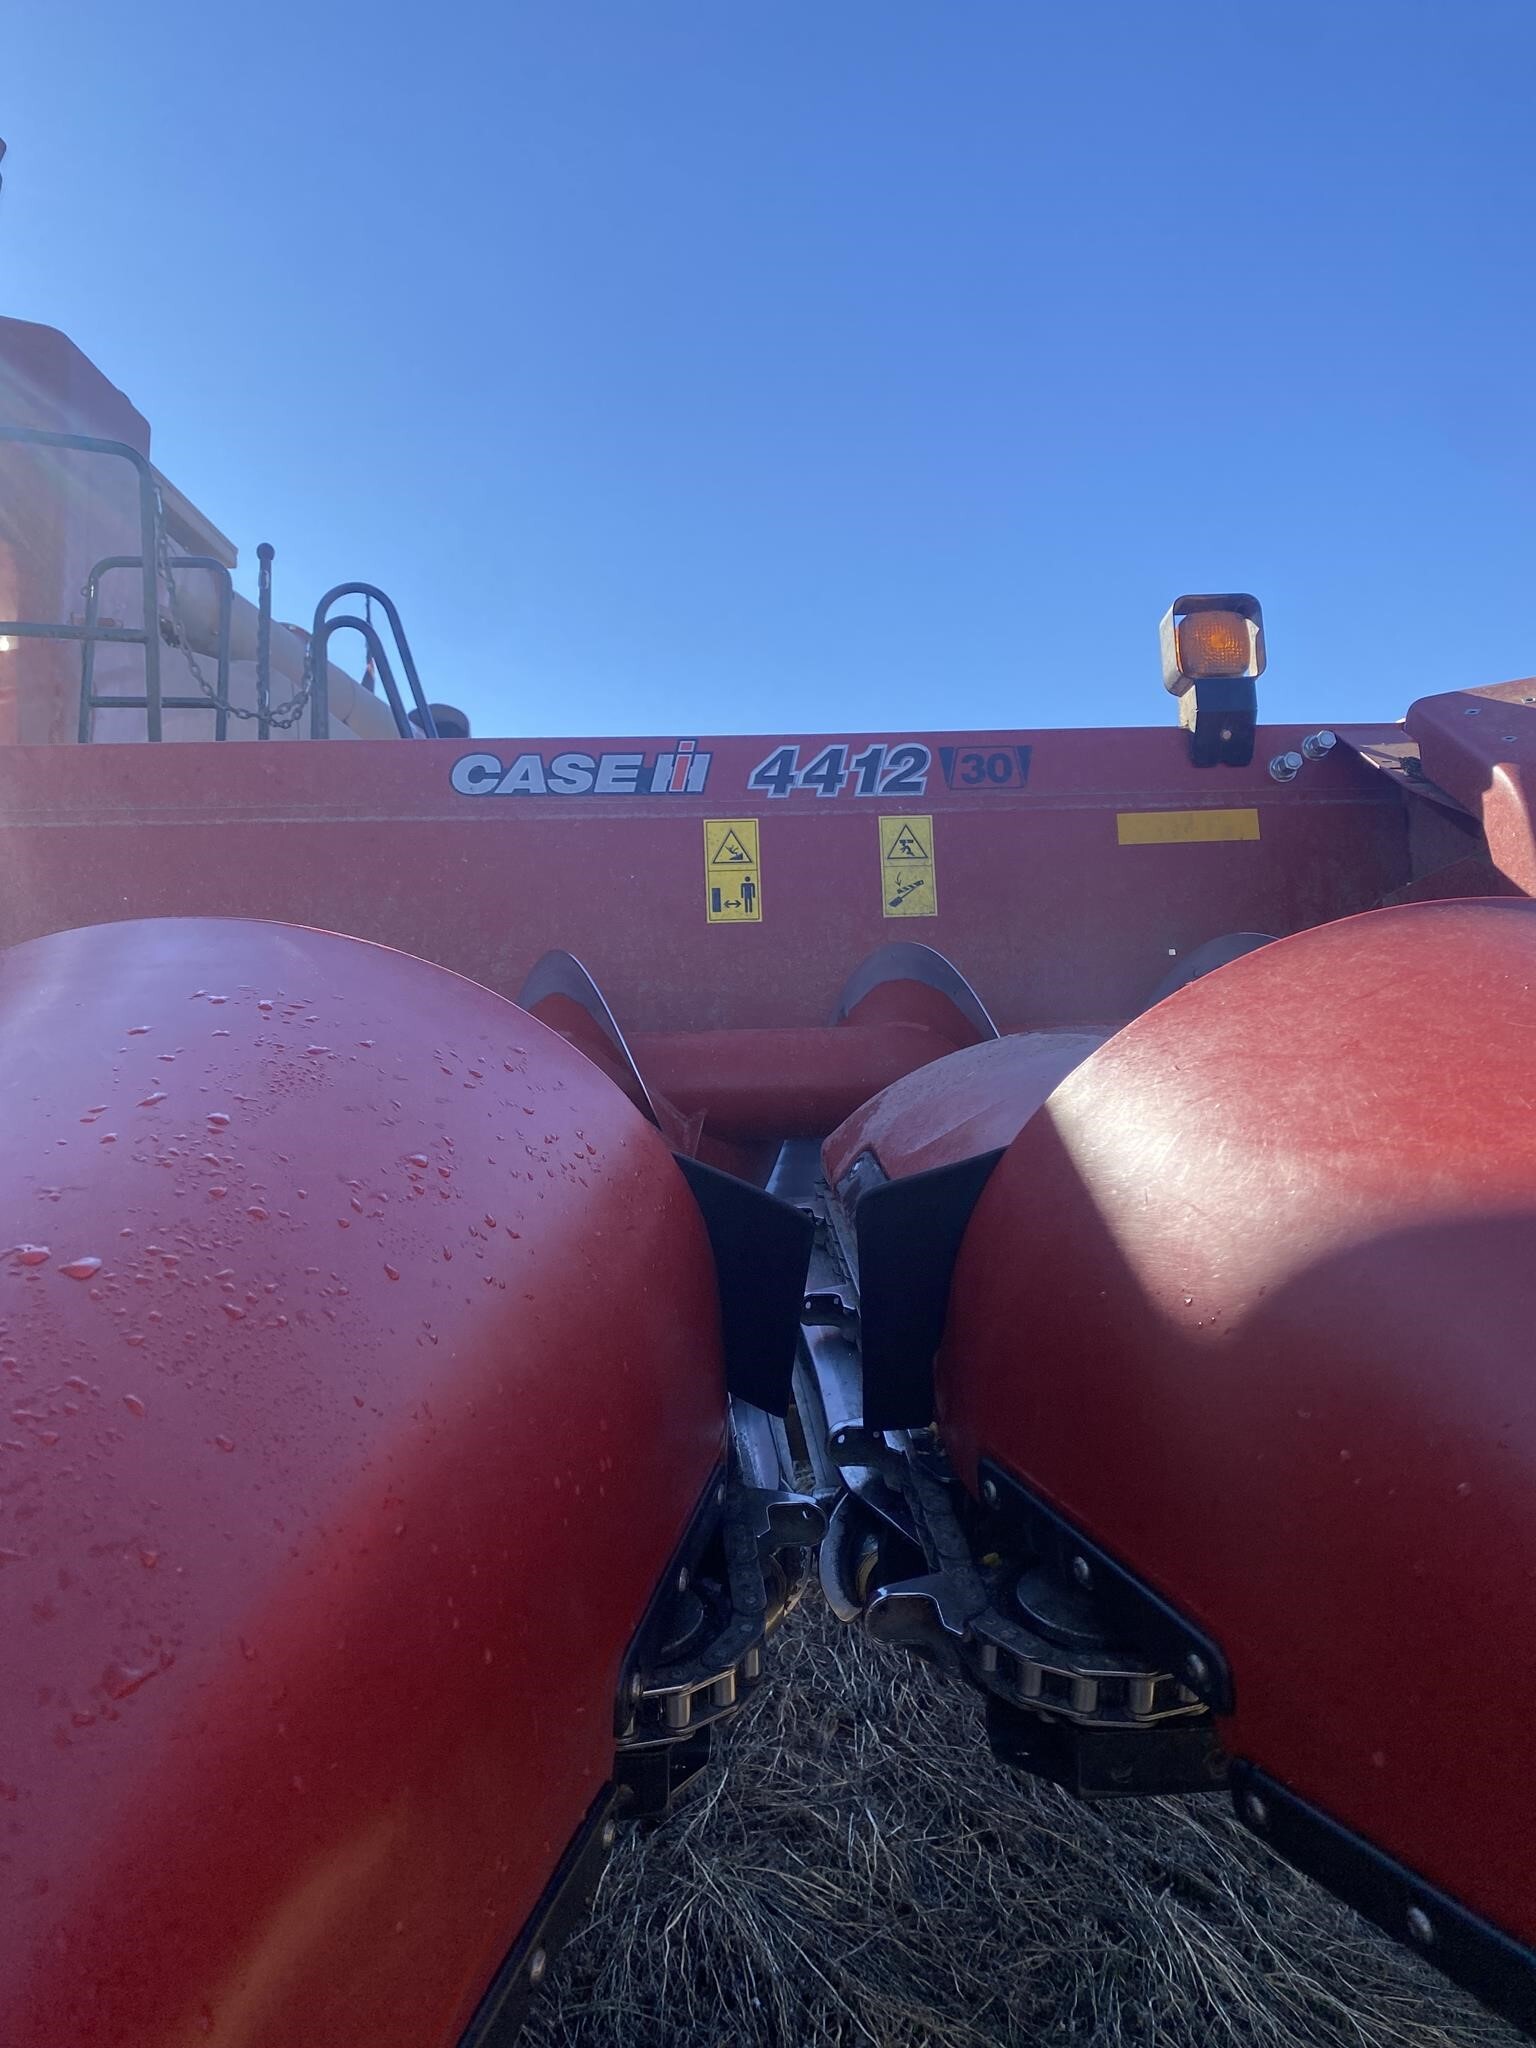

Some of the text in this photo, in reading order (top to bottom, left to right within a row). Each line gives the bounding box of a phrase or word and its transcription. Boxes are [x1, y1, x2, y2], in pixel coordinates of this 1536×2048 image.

[451, 753, 644, 795] CASE
[747, 743, 932, 798] 4412
[961, 753, 1013, 785] 30
